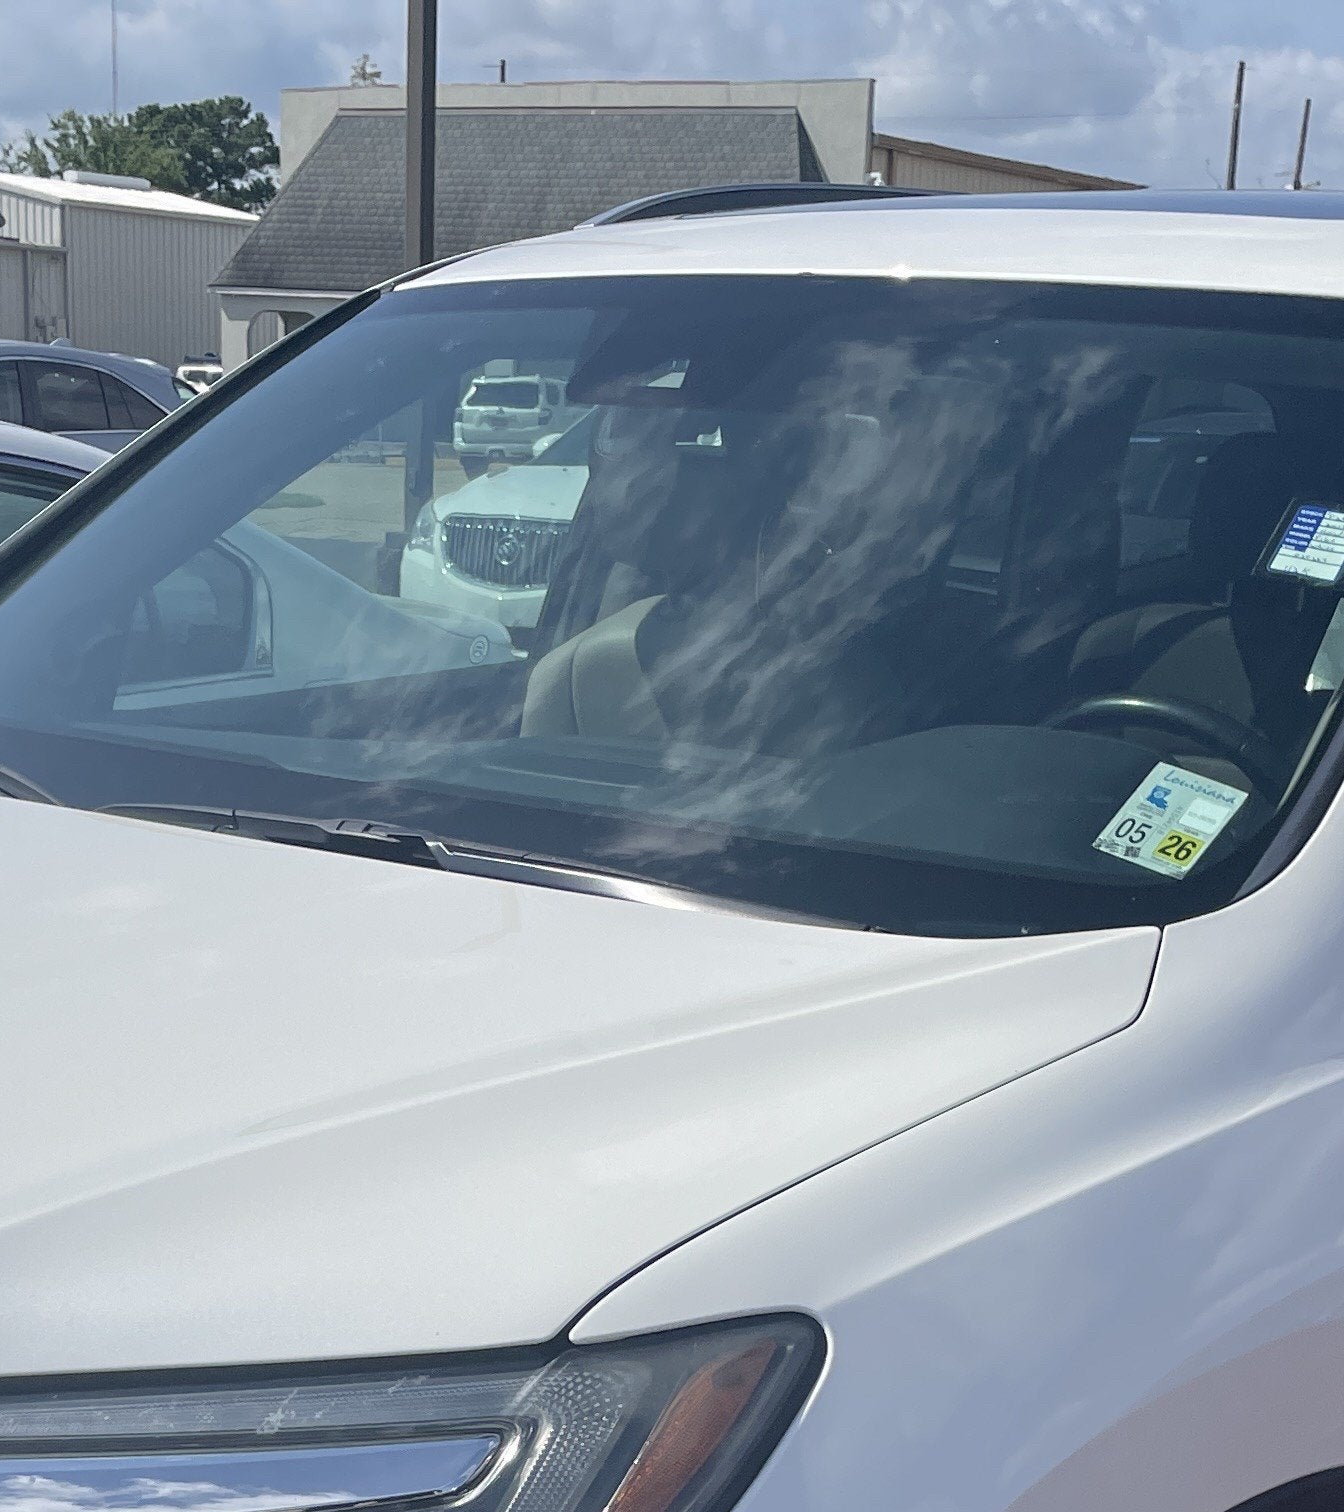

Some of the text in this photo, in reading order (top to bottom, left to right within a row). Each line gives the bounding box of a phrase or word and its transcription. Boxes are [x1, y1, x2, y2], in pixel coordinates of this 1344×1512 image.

[1163, 769, 1236, 804] Louisiana
[1114, 817, 1153, 844] 05
[1157, 834, 1198, 861] 26
